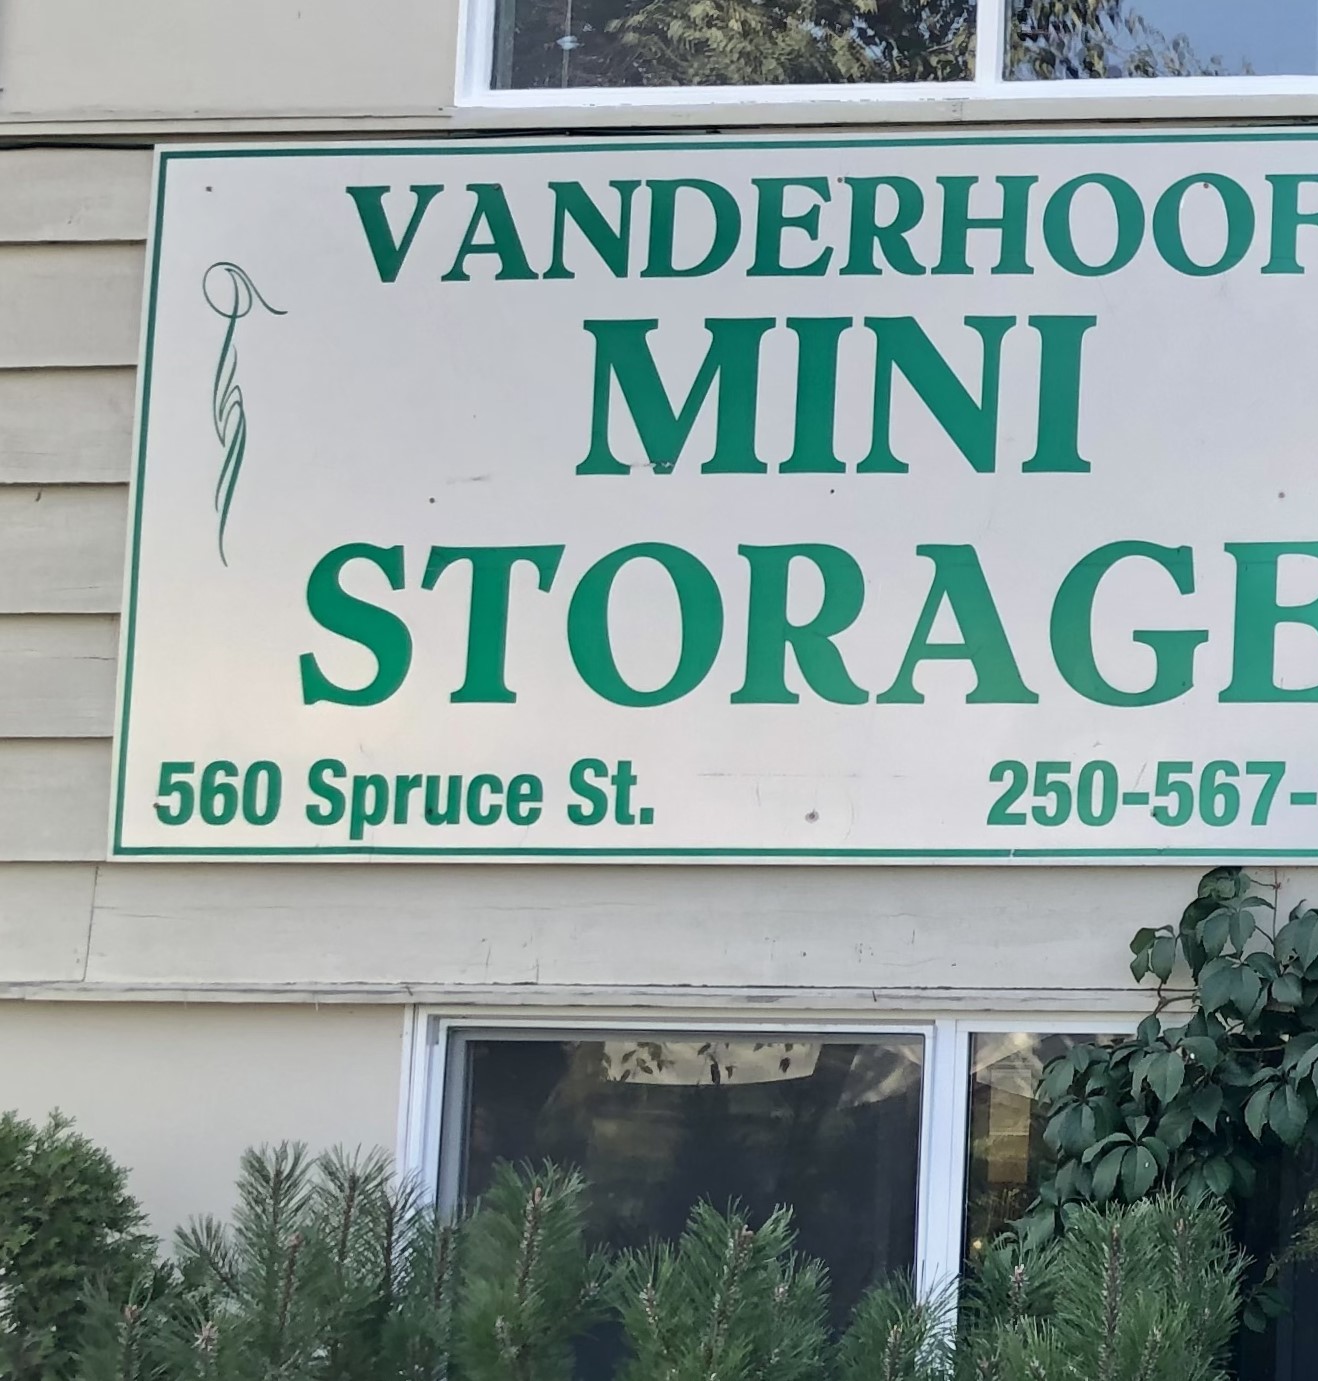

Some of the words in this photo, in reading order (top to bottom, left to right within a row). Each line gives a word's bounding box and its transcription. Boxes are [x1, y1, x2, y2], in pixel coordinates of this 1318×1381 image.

[576, 316, 1097, 475] MINI
[156, 760, 282, 826] 560
[306, 758, 543, 841] Spruce
[567, 758, 654, 826] St.
